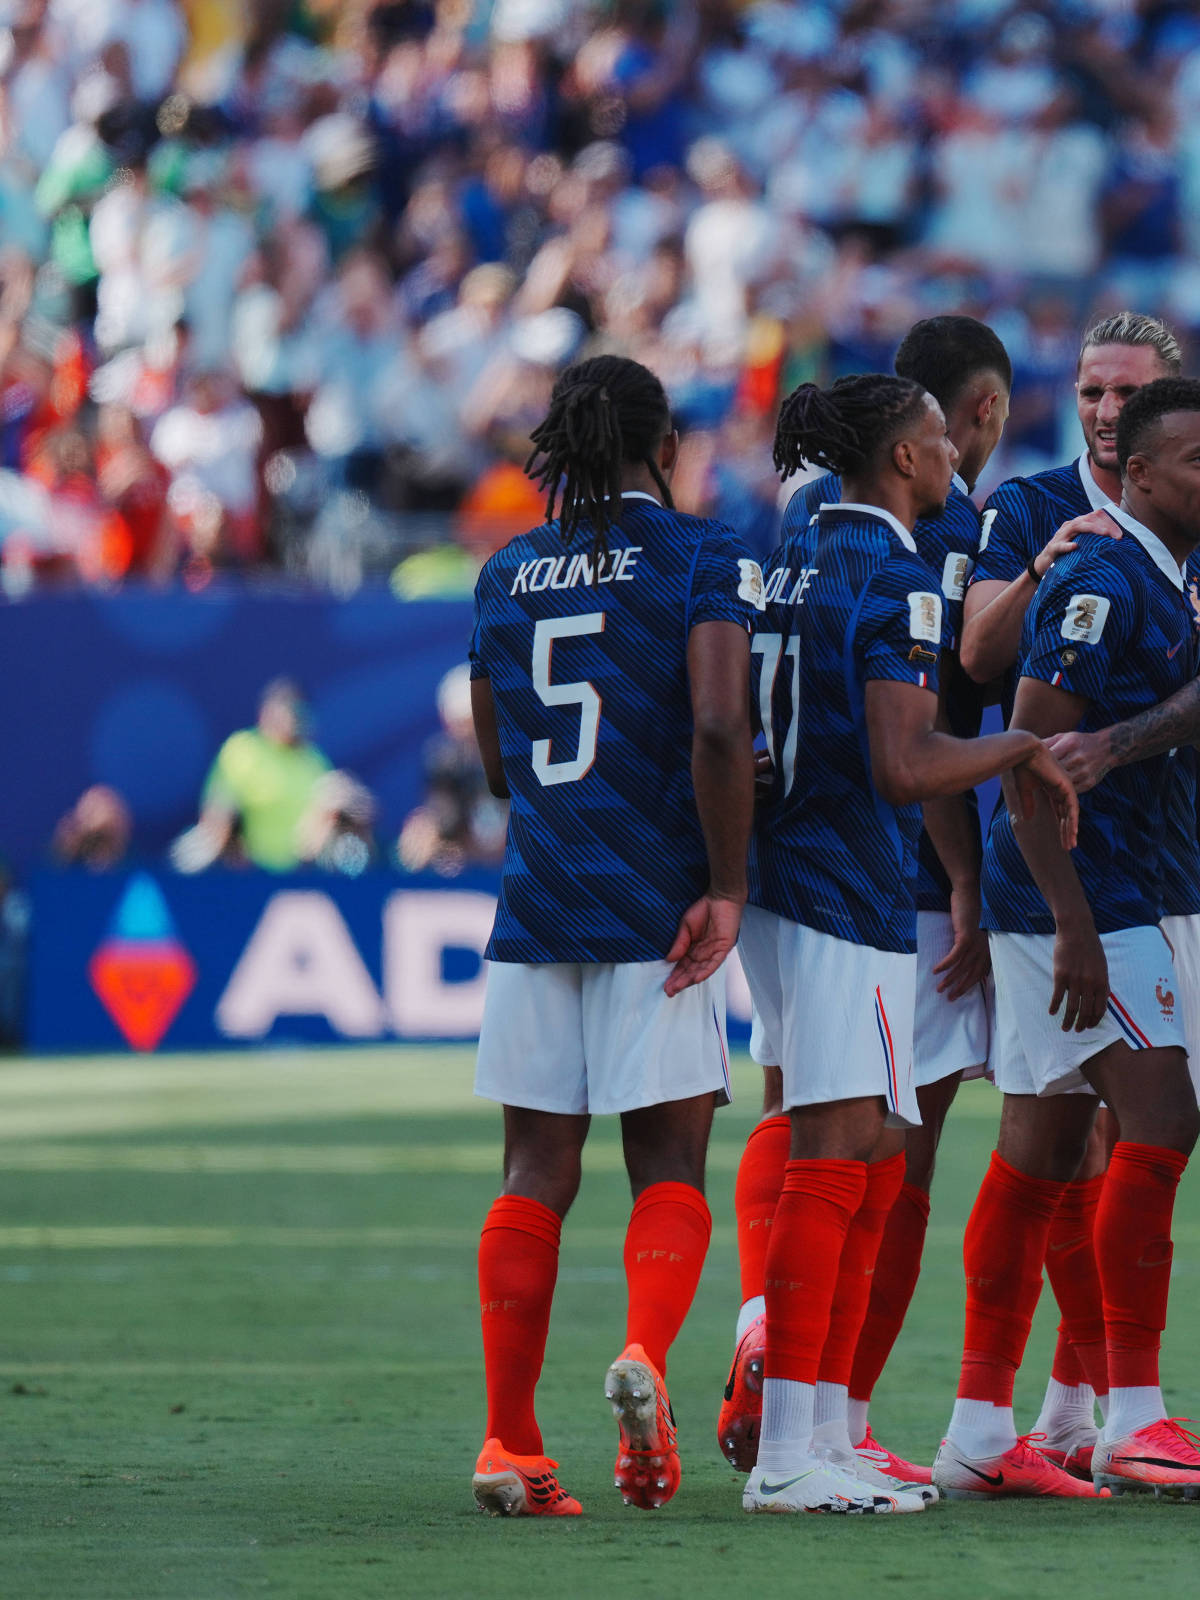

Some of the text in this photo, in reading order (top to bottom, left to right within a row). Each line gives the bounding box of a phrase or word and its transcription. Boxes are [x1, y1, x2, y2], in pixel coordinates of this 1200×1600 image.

[510, 546, 643, 596] KOUNDE
[531, 612, 605, 786] 5
[637, 1250, 684, 1264] FFF
